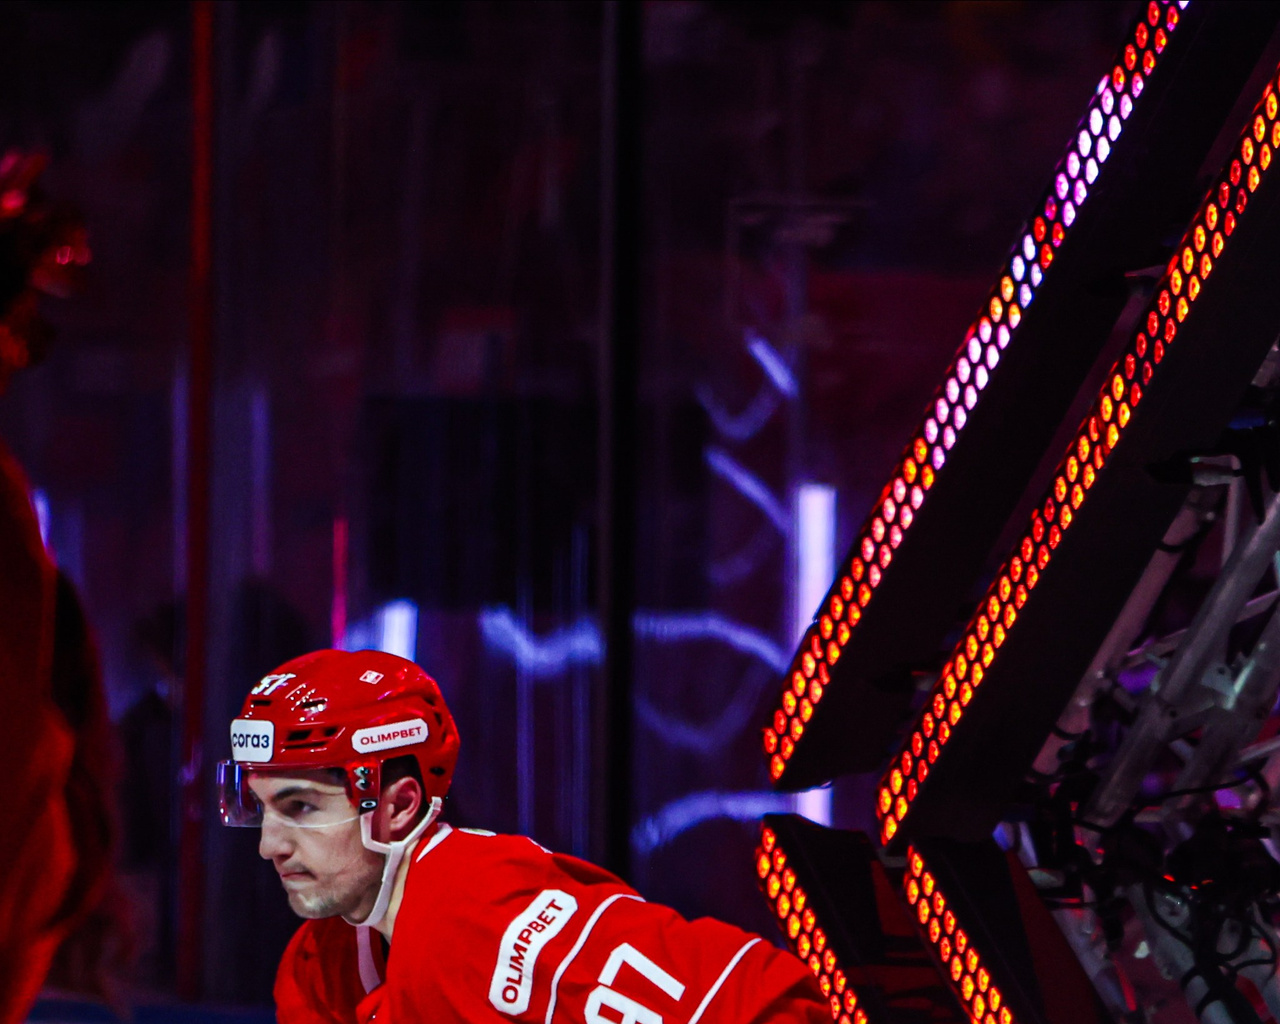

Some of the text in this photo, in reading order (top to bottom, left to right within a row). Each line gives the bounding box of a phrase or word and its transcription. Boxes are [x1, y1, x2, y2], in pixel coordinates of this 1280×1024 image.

[232, 733, 270, 748] согаз
[360, 726, 422, 746] OLIMPBET
[502, 899, 563, 1004] OLIMPBET
